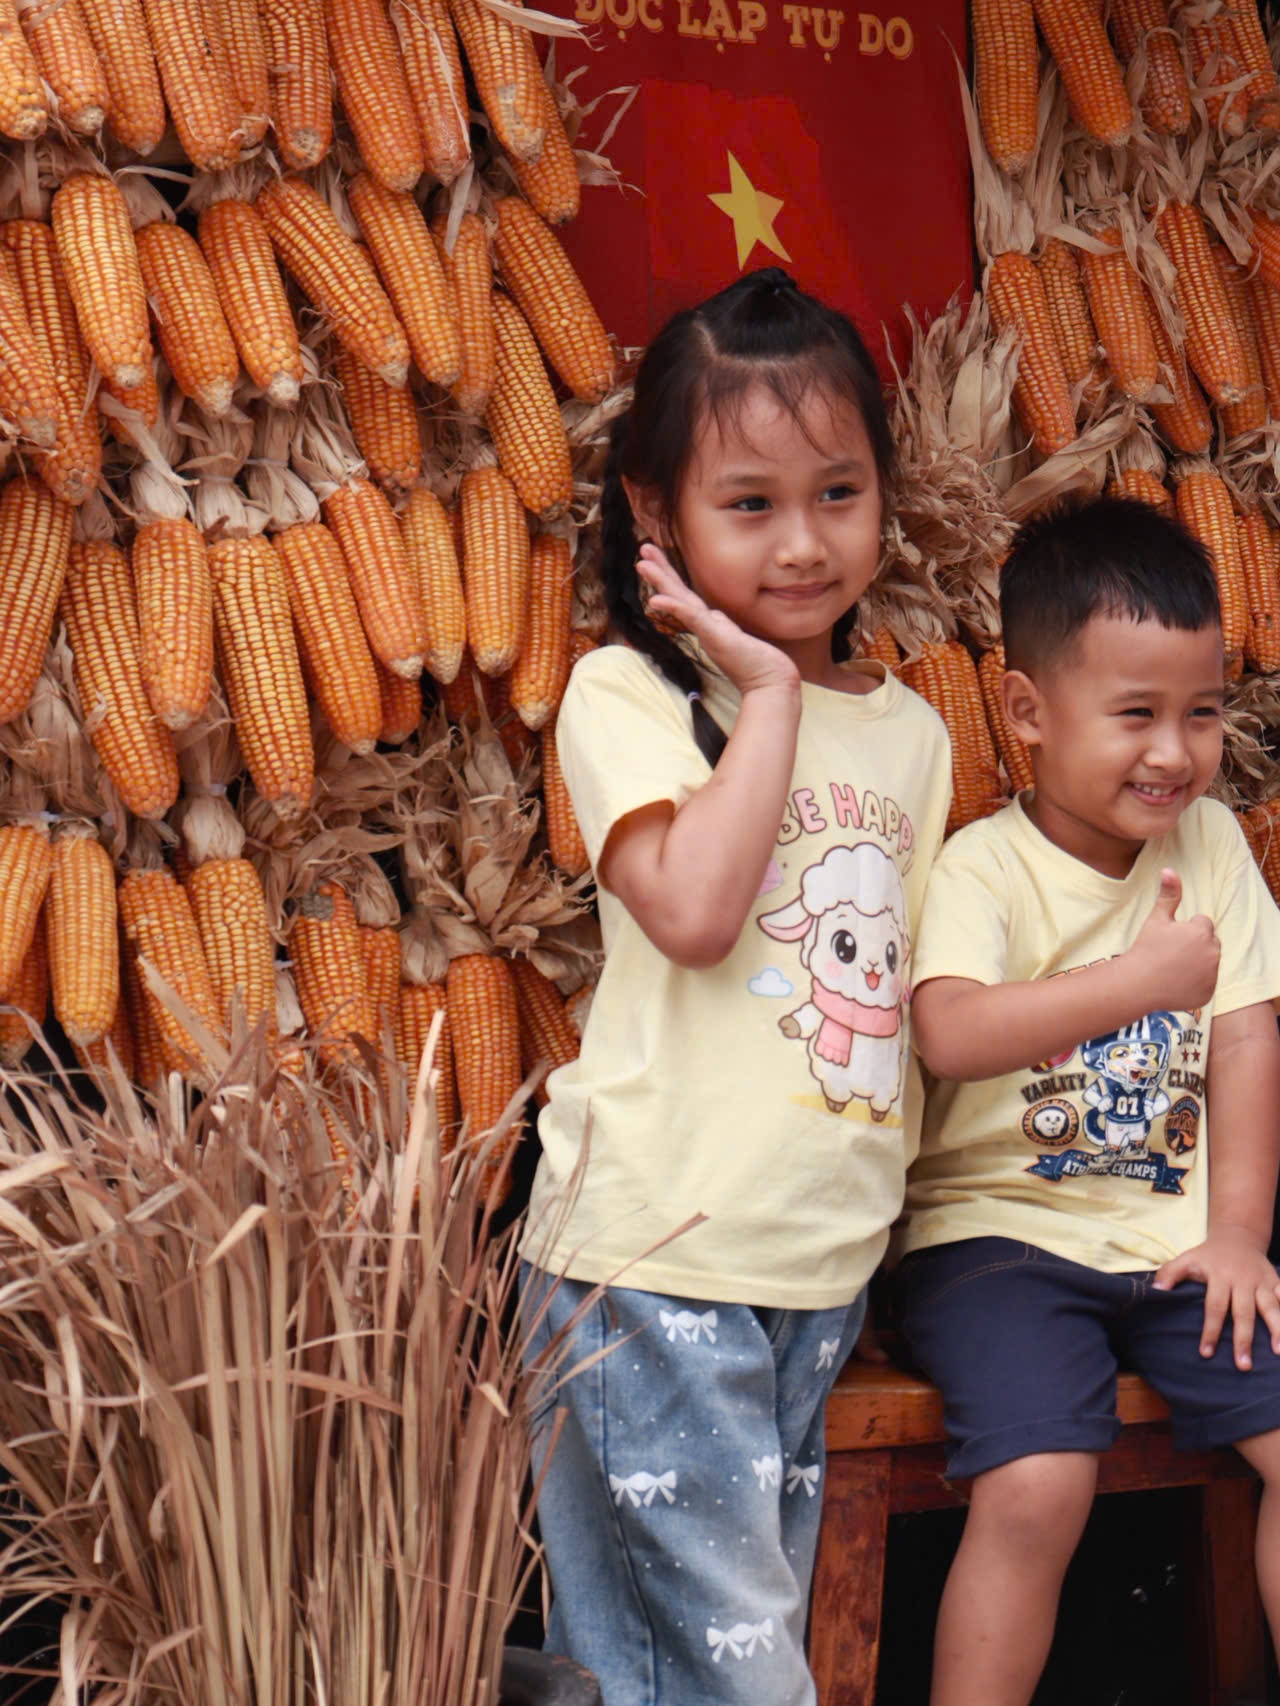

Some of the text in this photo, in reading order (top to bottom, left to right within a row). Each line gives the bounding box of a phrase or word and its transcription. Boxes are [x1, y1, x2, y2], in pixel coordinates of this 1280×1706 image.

[858, 13, 914, 60] DO
[1020, 1072, 1087, 1104] VARLITY
[1116, 1095, 1139, 1115] 07
[1111, 1162, 1158, 1179] CHAMPS
